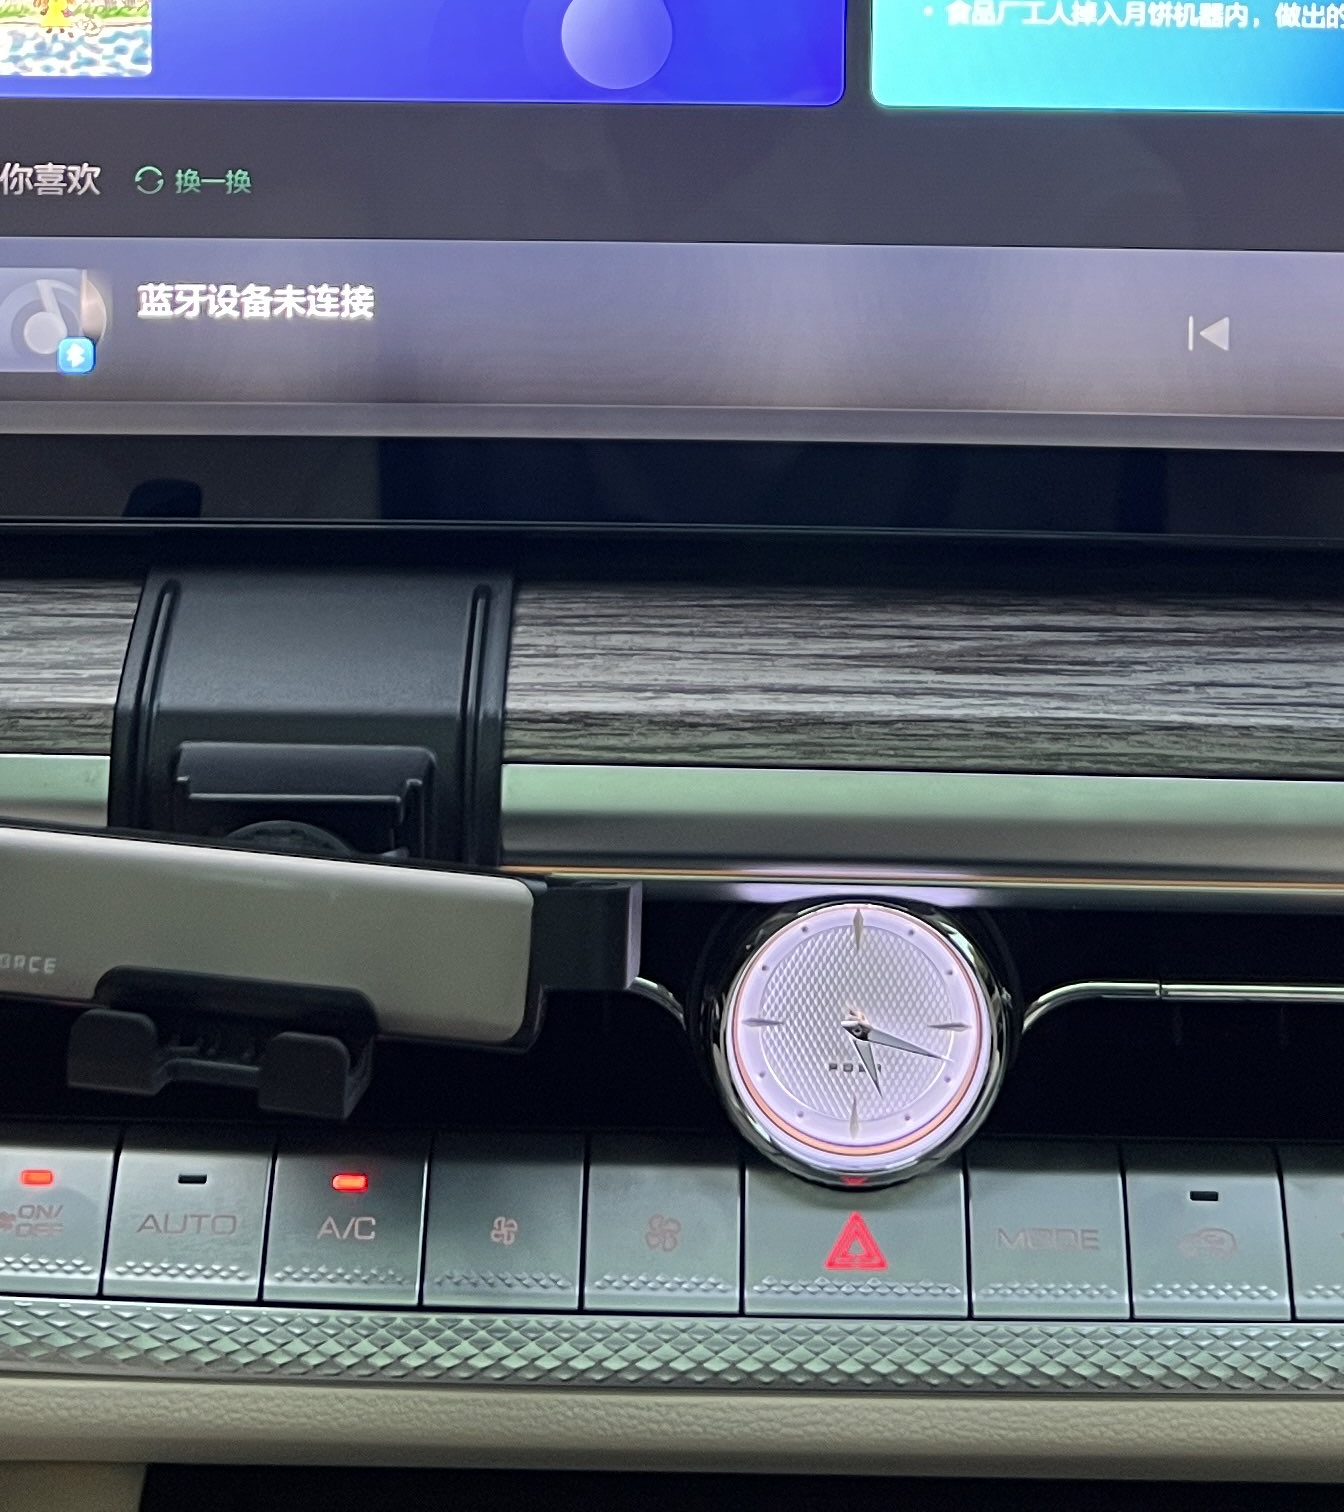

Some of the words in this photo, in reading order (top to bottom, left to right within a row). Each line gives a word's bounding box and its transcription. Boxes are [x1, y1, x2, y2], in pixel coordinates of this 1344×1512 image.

[174, 168, 252, 194] 换一换
[136, 282, 375, 321] 蓝牙设备未连接
[136, 1212, 239, 1236] AUTO
[317, 1216, 377, 1241] A/C
